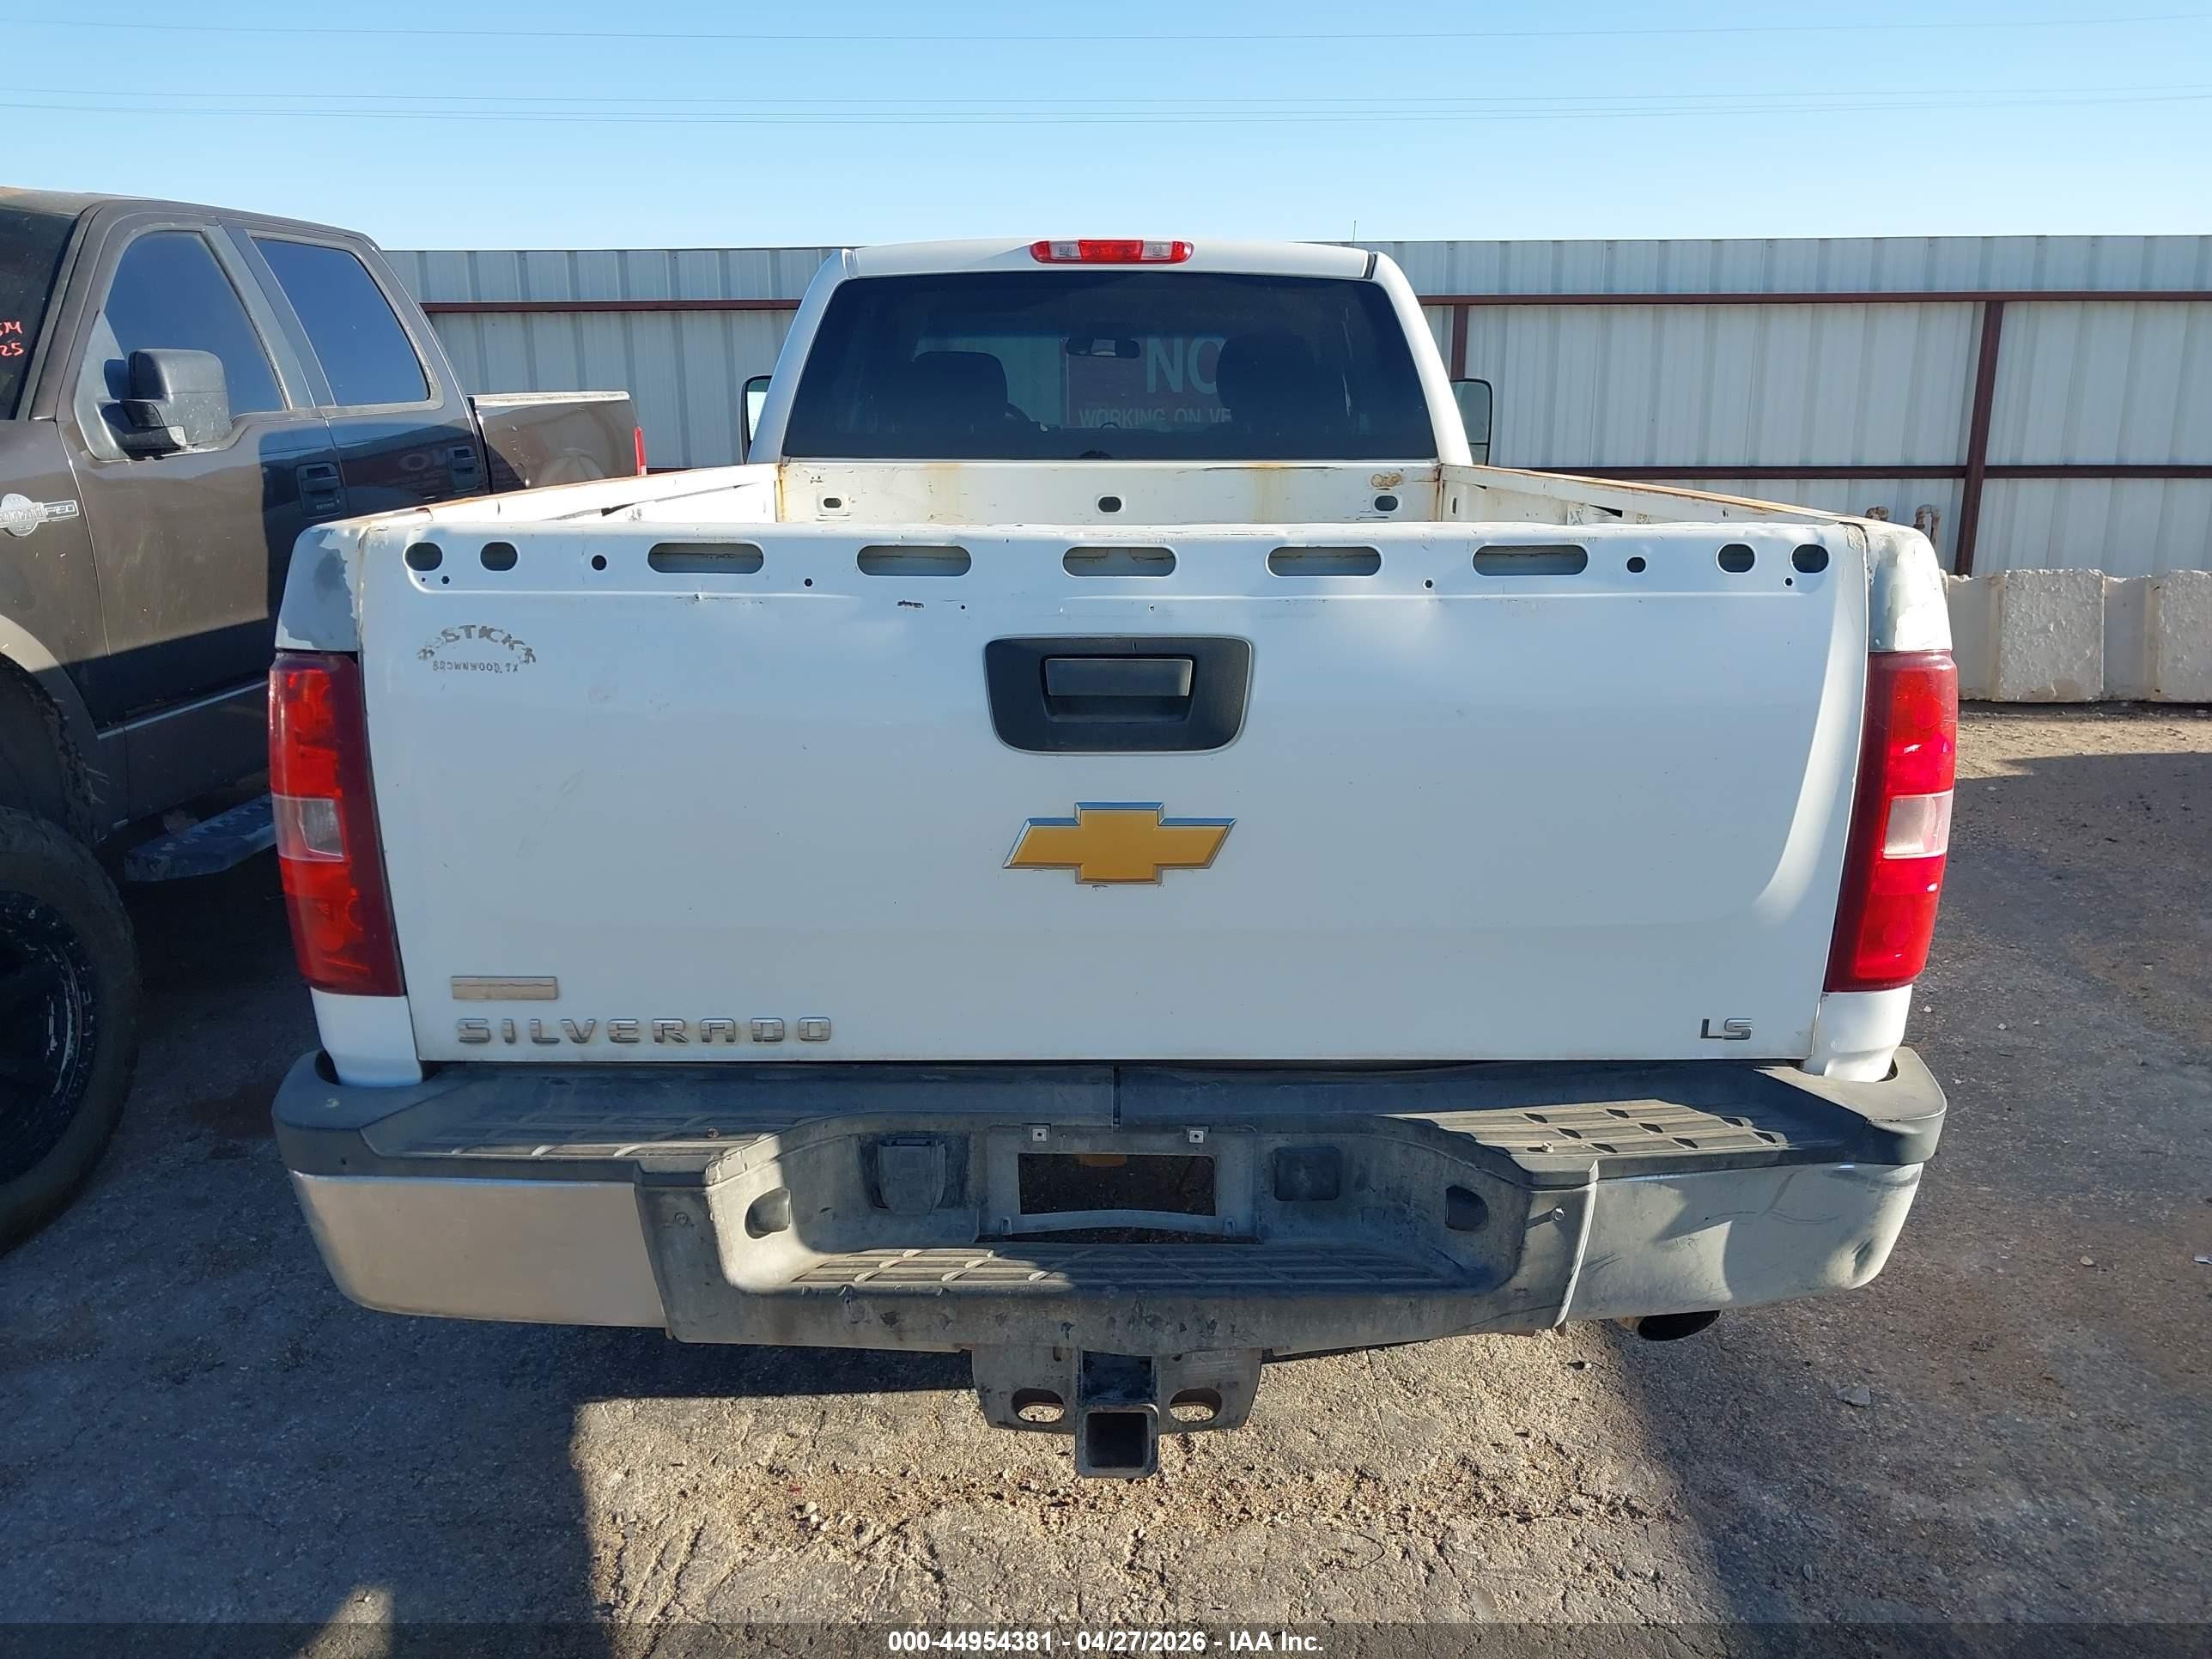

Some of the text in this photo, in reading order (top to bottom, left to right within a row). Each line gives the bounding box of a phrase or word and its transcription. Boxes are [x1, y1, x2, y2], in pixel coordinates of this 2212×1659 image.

[1079, 408, 1166, 429] WORKING
[458, 1018, 832, 1044] SILVERADO
[1700, 1018, 1752, 1040] LS
